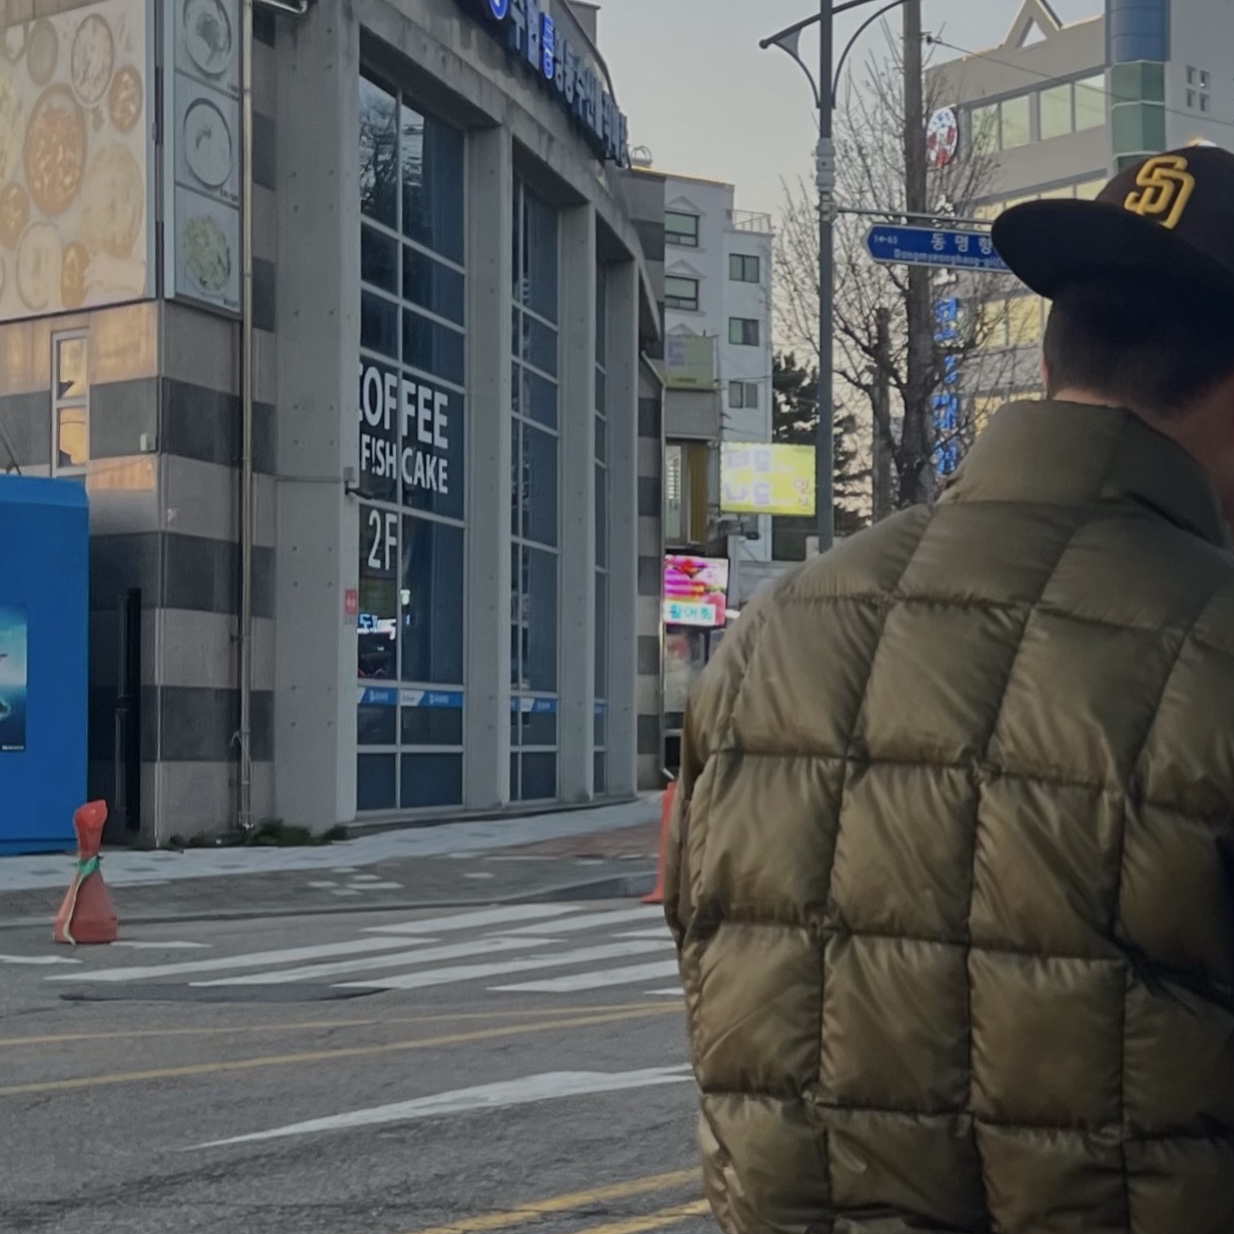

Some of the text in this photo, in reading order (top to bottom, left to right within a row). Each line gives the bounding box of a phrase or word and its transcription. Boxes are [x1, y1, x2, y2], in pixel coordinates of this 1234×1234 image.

[359, 363, 449, 449] OFFEE
[401, 447, 449, 494] CAKE
[368, 509, 397, 570] 2F
